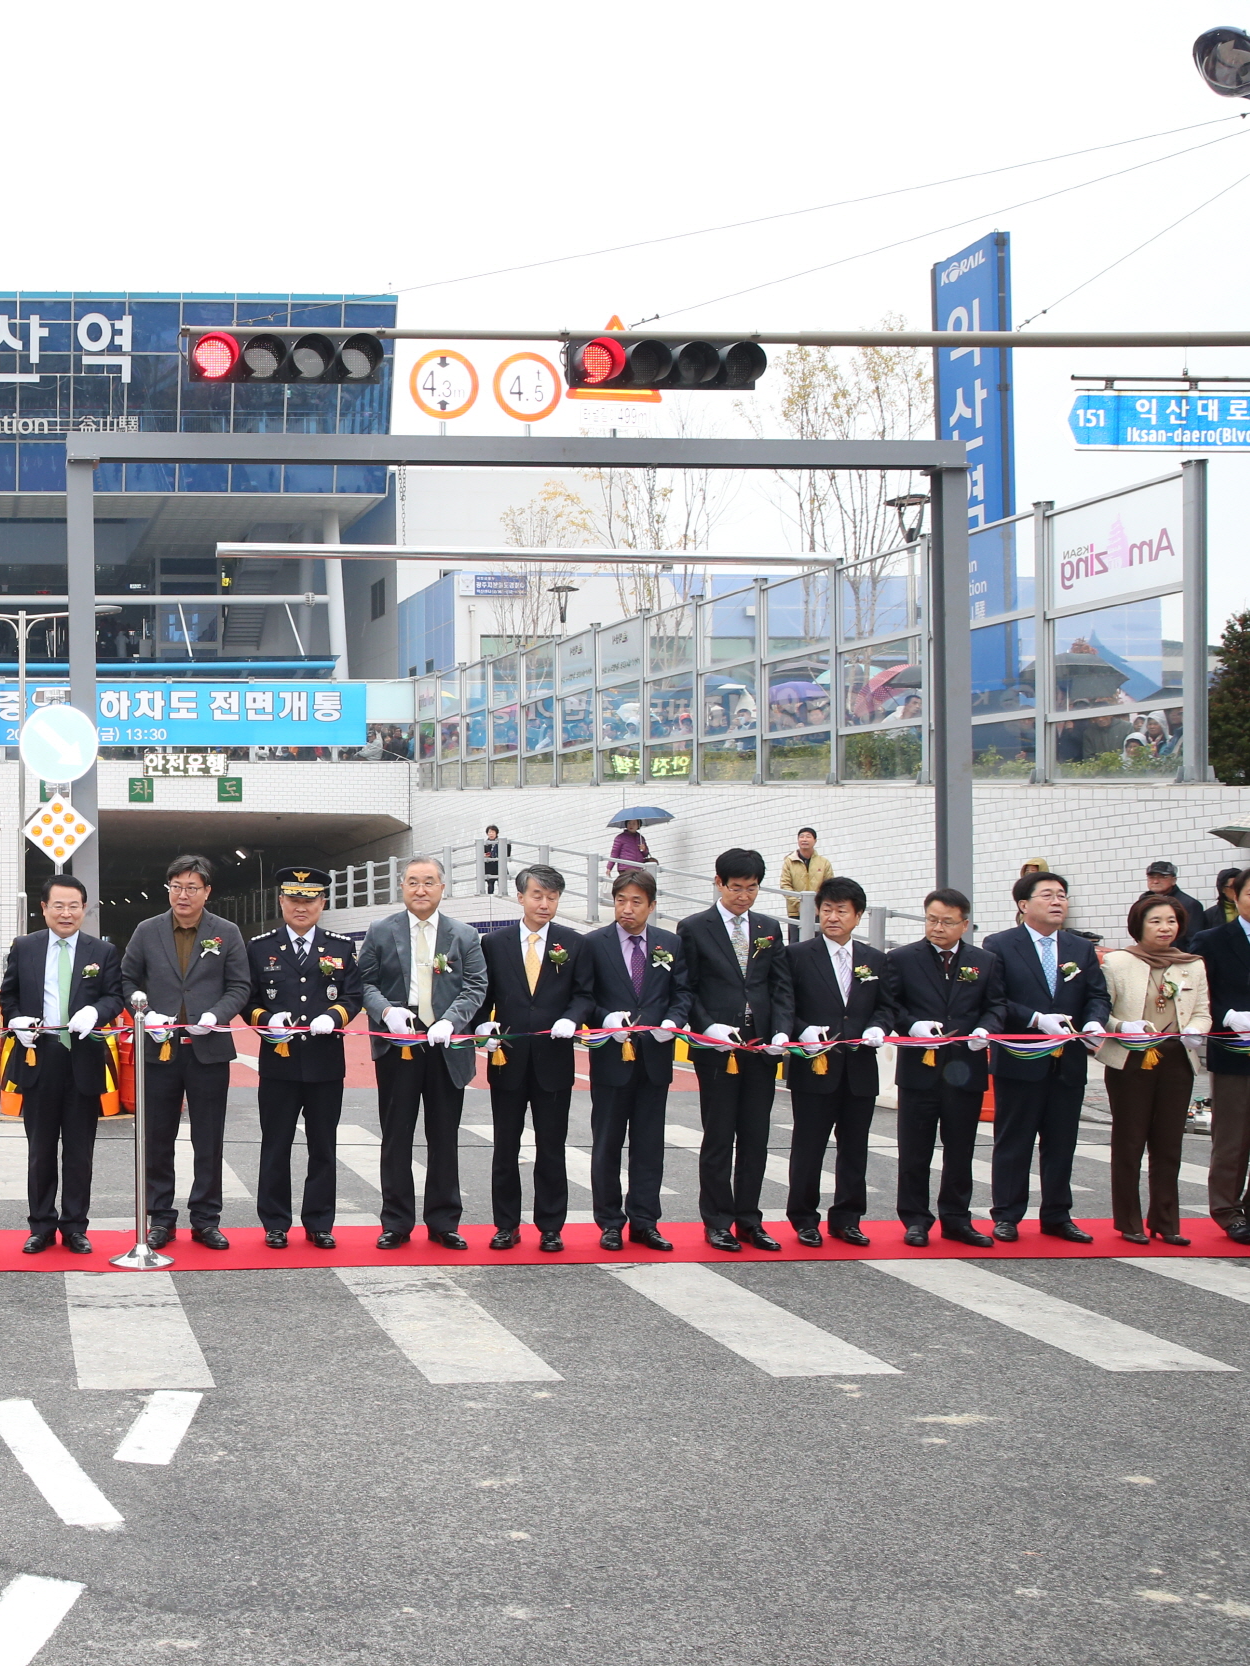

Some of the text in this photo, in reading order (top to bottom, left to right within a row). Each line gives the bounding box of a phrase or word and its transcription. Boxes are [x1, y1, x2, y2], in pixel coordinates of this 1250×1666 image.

[940, 249, 986, 287] KORAIL
[1076, 409, 1105, 427] 151
[1135, 398, 1250, 425] 익산대로
[208, 690, 342, 722] 전면개통
[126, 728, 168, 741] 13:30
[145, 754, 226, 776] 안전운행
